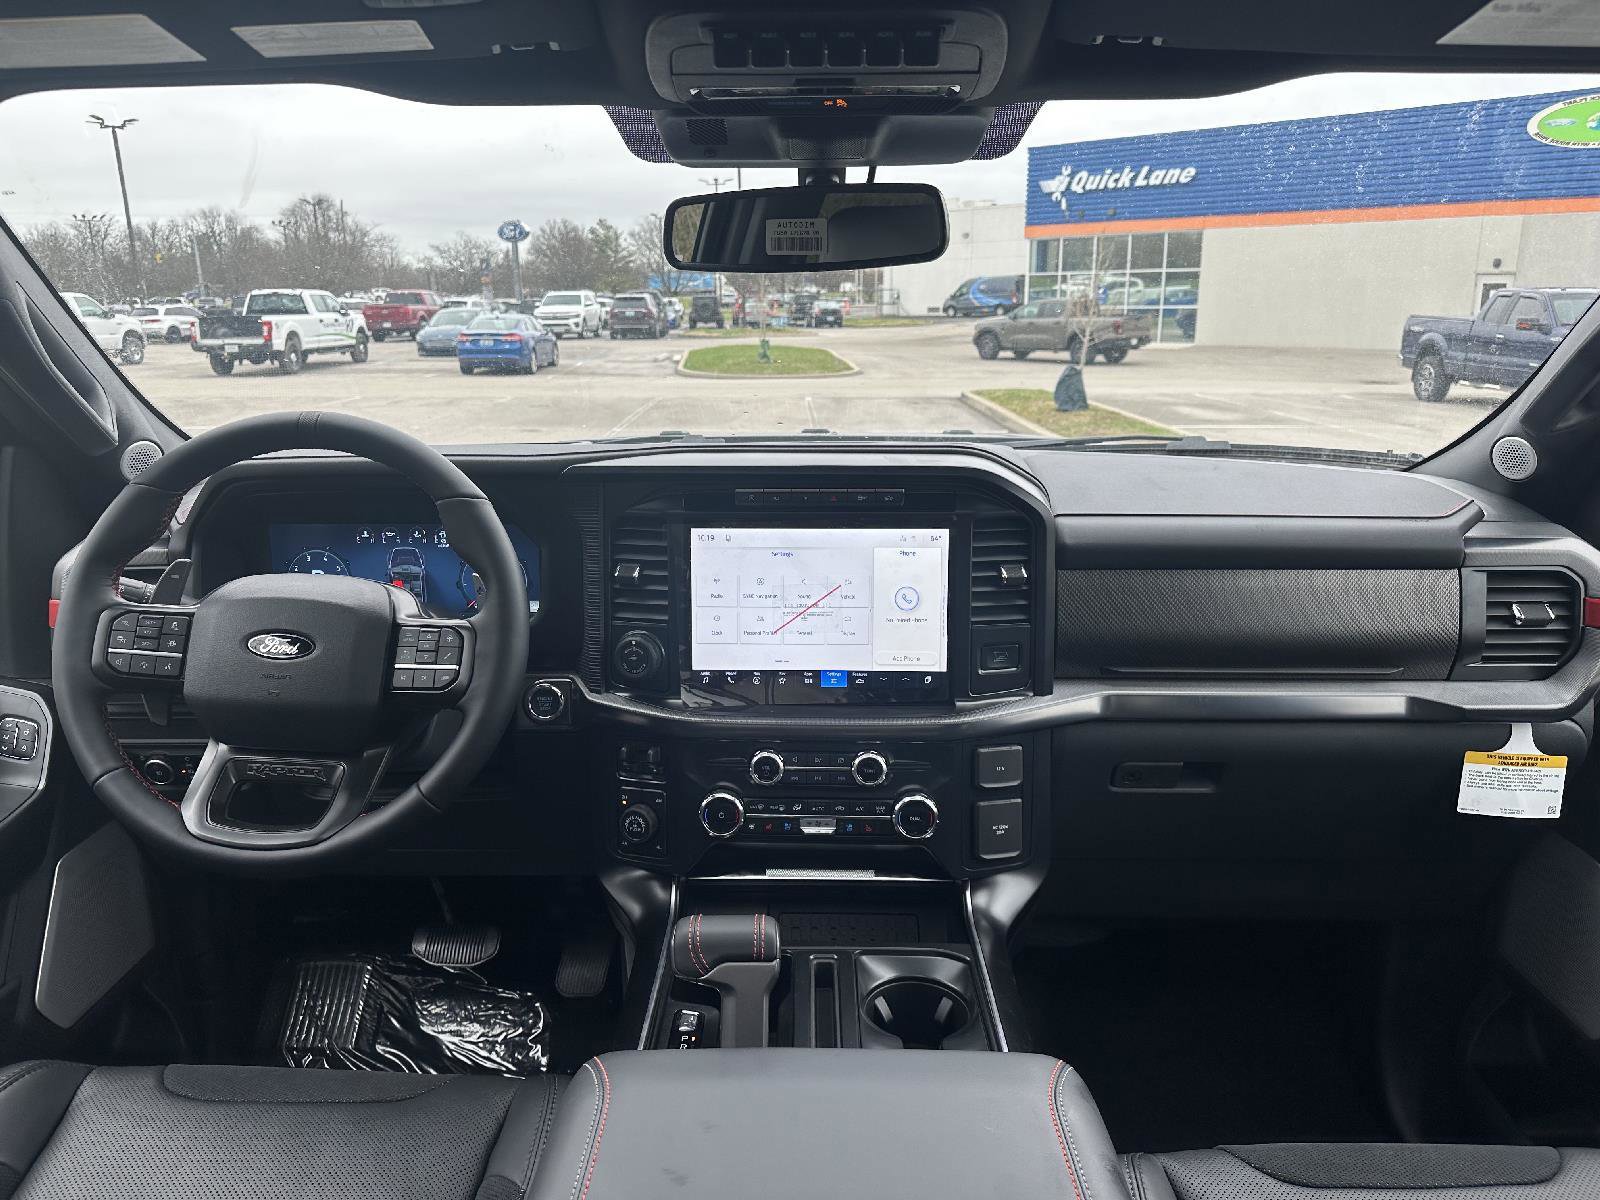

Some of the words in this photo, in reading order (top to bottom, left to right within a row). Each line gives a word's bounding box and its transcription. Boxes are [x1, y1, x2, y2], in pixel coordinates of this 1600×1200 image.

[1071, 165, 1136, 194] Quick
[1134, 165, 1197, 187] Lane
[260, 636, 300, 654] Ford
[247, 763, 325, 781] RAPTOR
